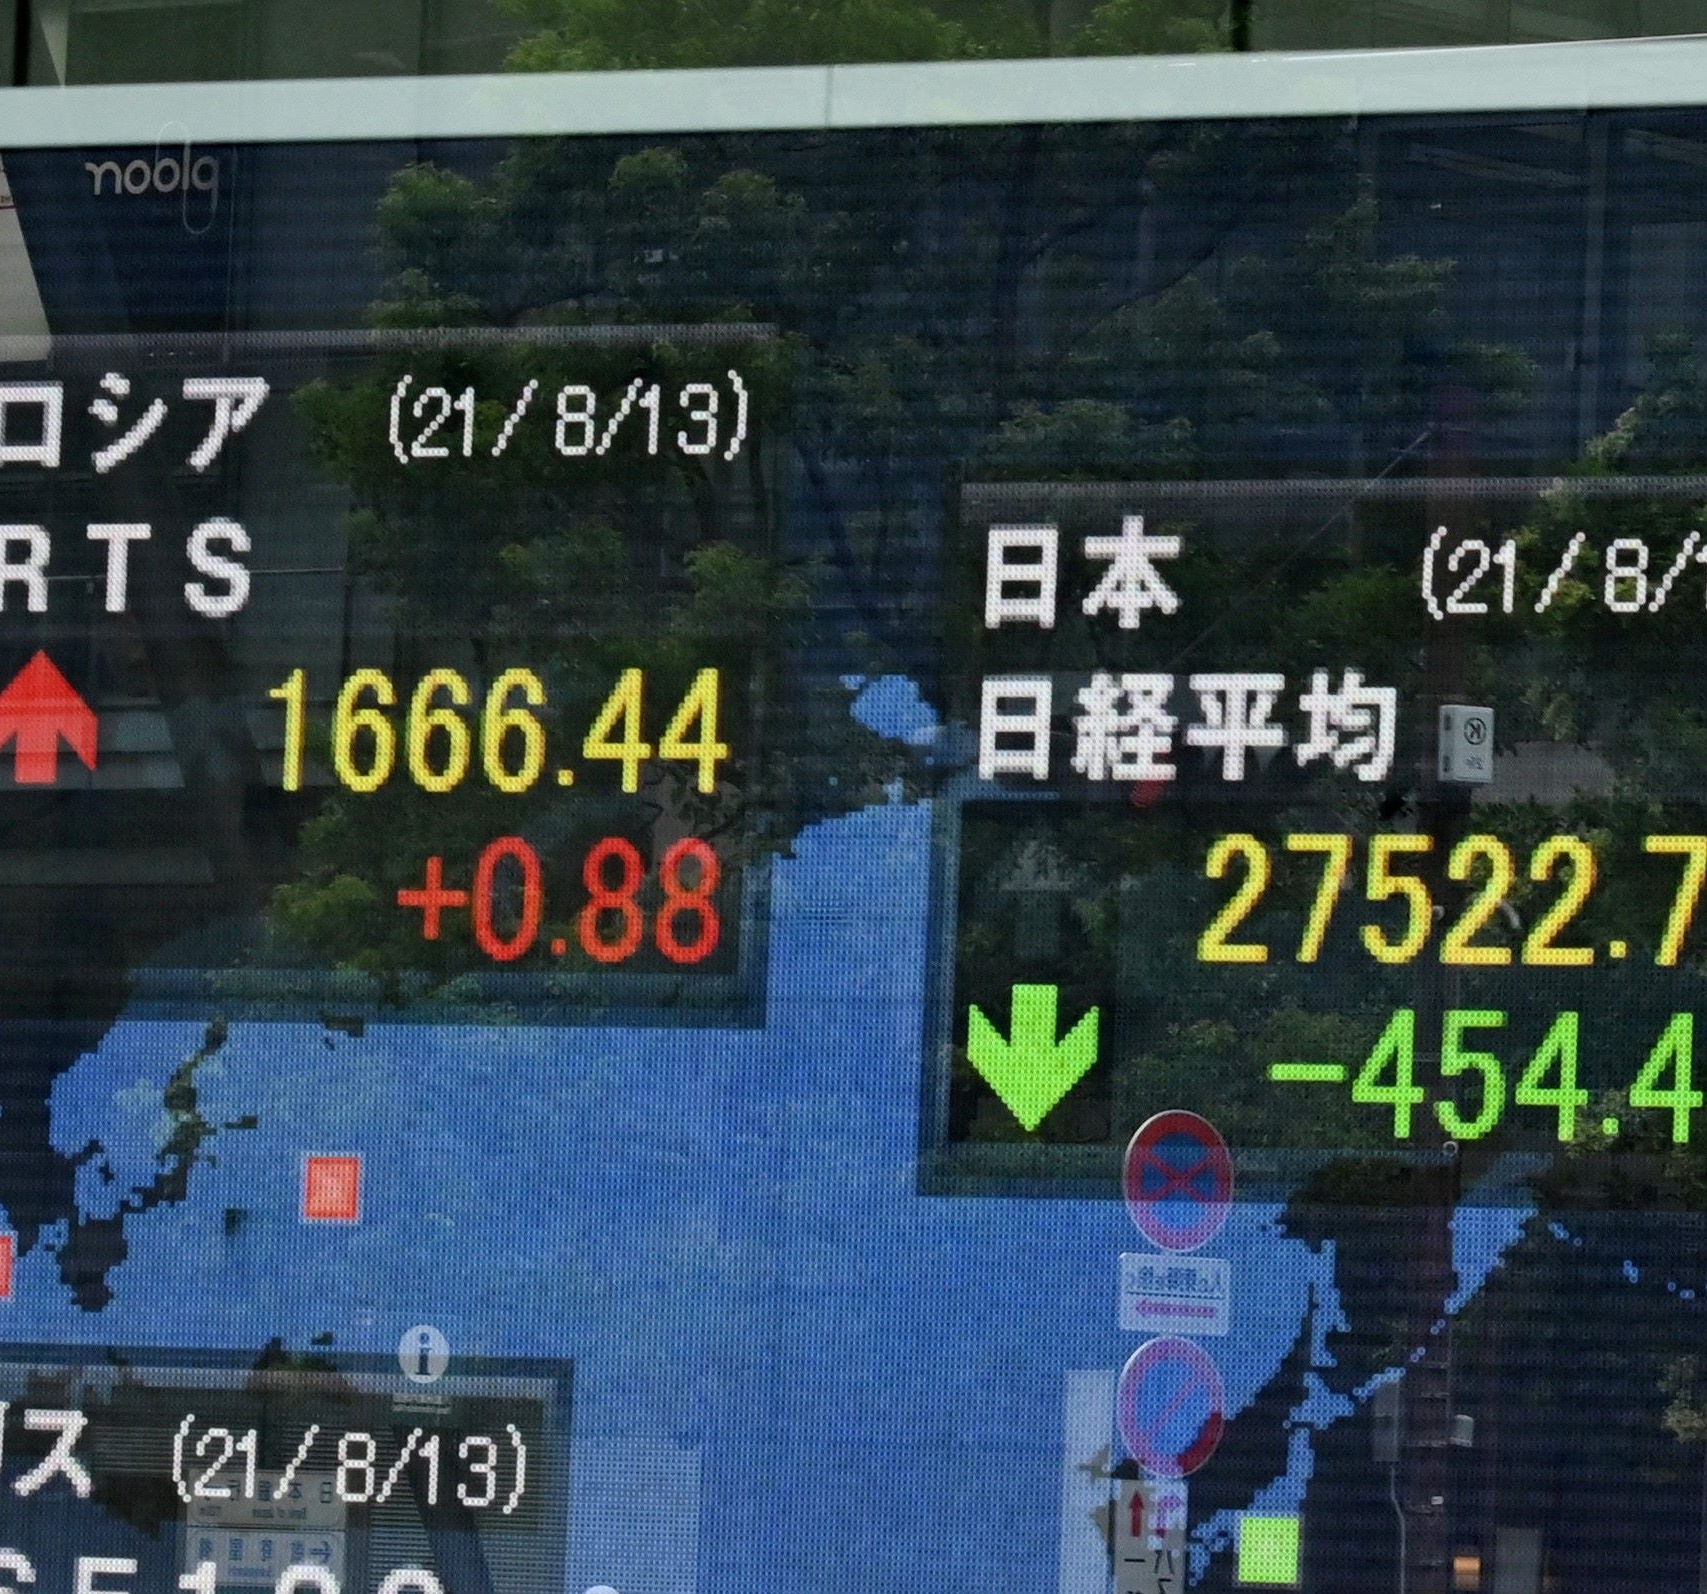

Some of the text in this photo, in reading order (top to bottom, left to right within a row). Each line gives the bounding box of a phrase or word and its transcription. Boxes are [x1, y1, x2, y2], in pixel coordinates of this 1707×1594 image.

[984, 514, 1182, 630] 日本
[269, 666, 728, 795] 1666.44
[978, 667, 1397, 784] 日経平均
[396, 834, 722, 965] +0.88
